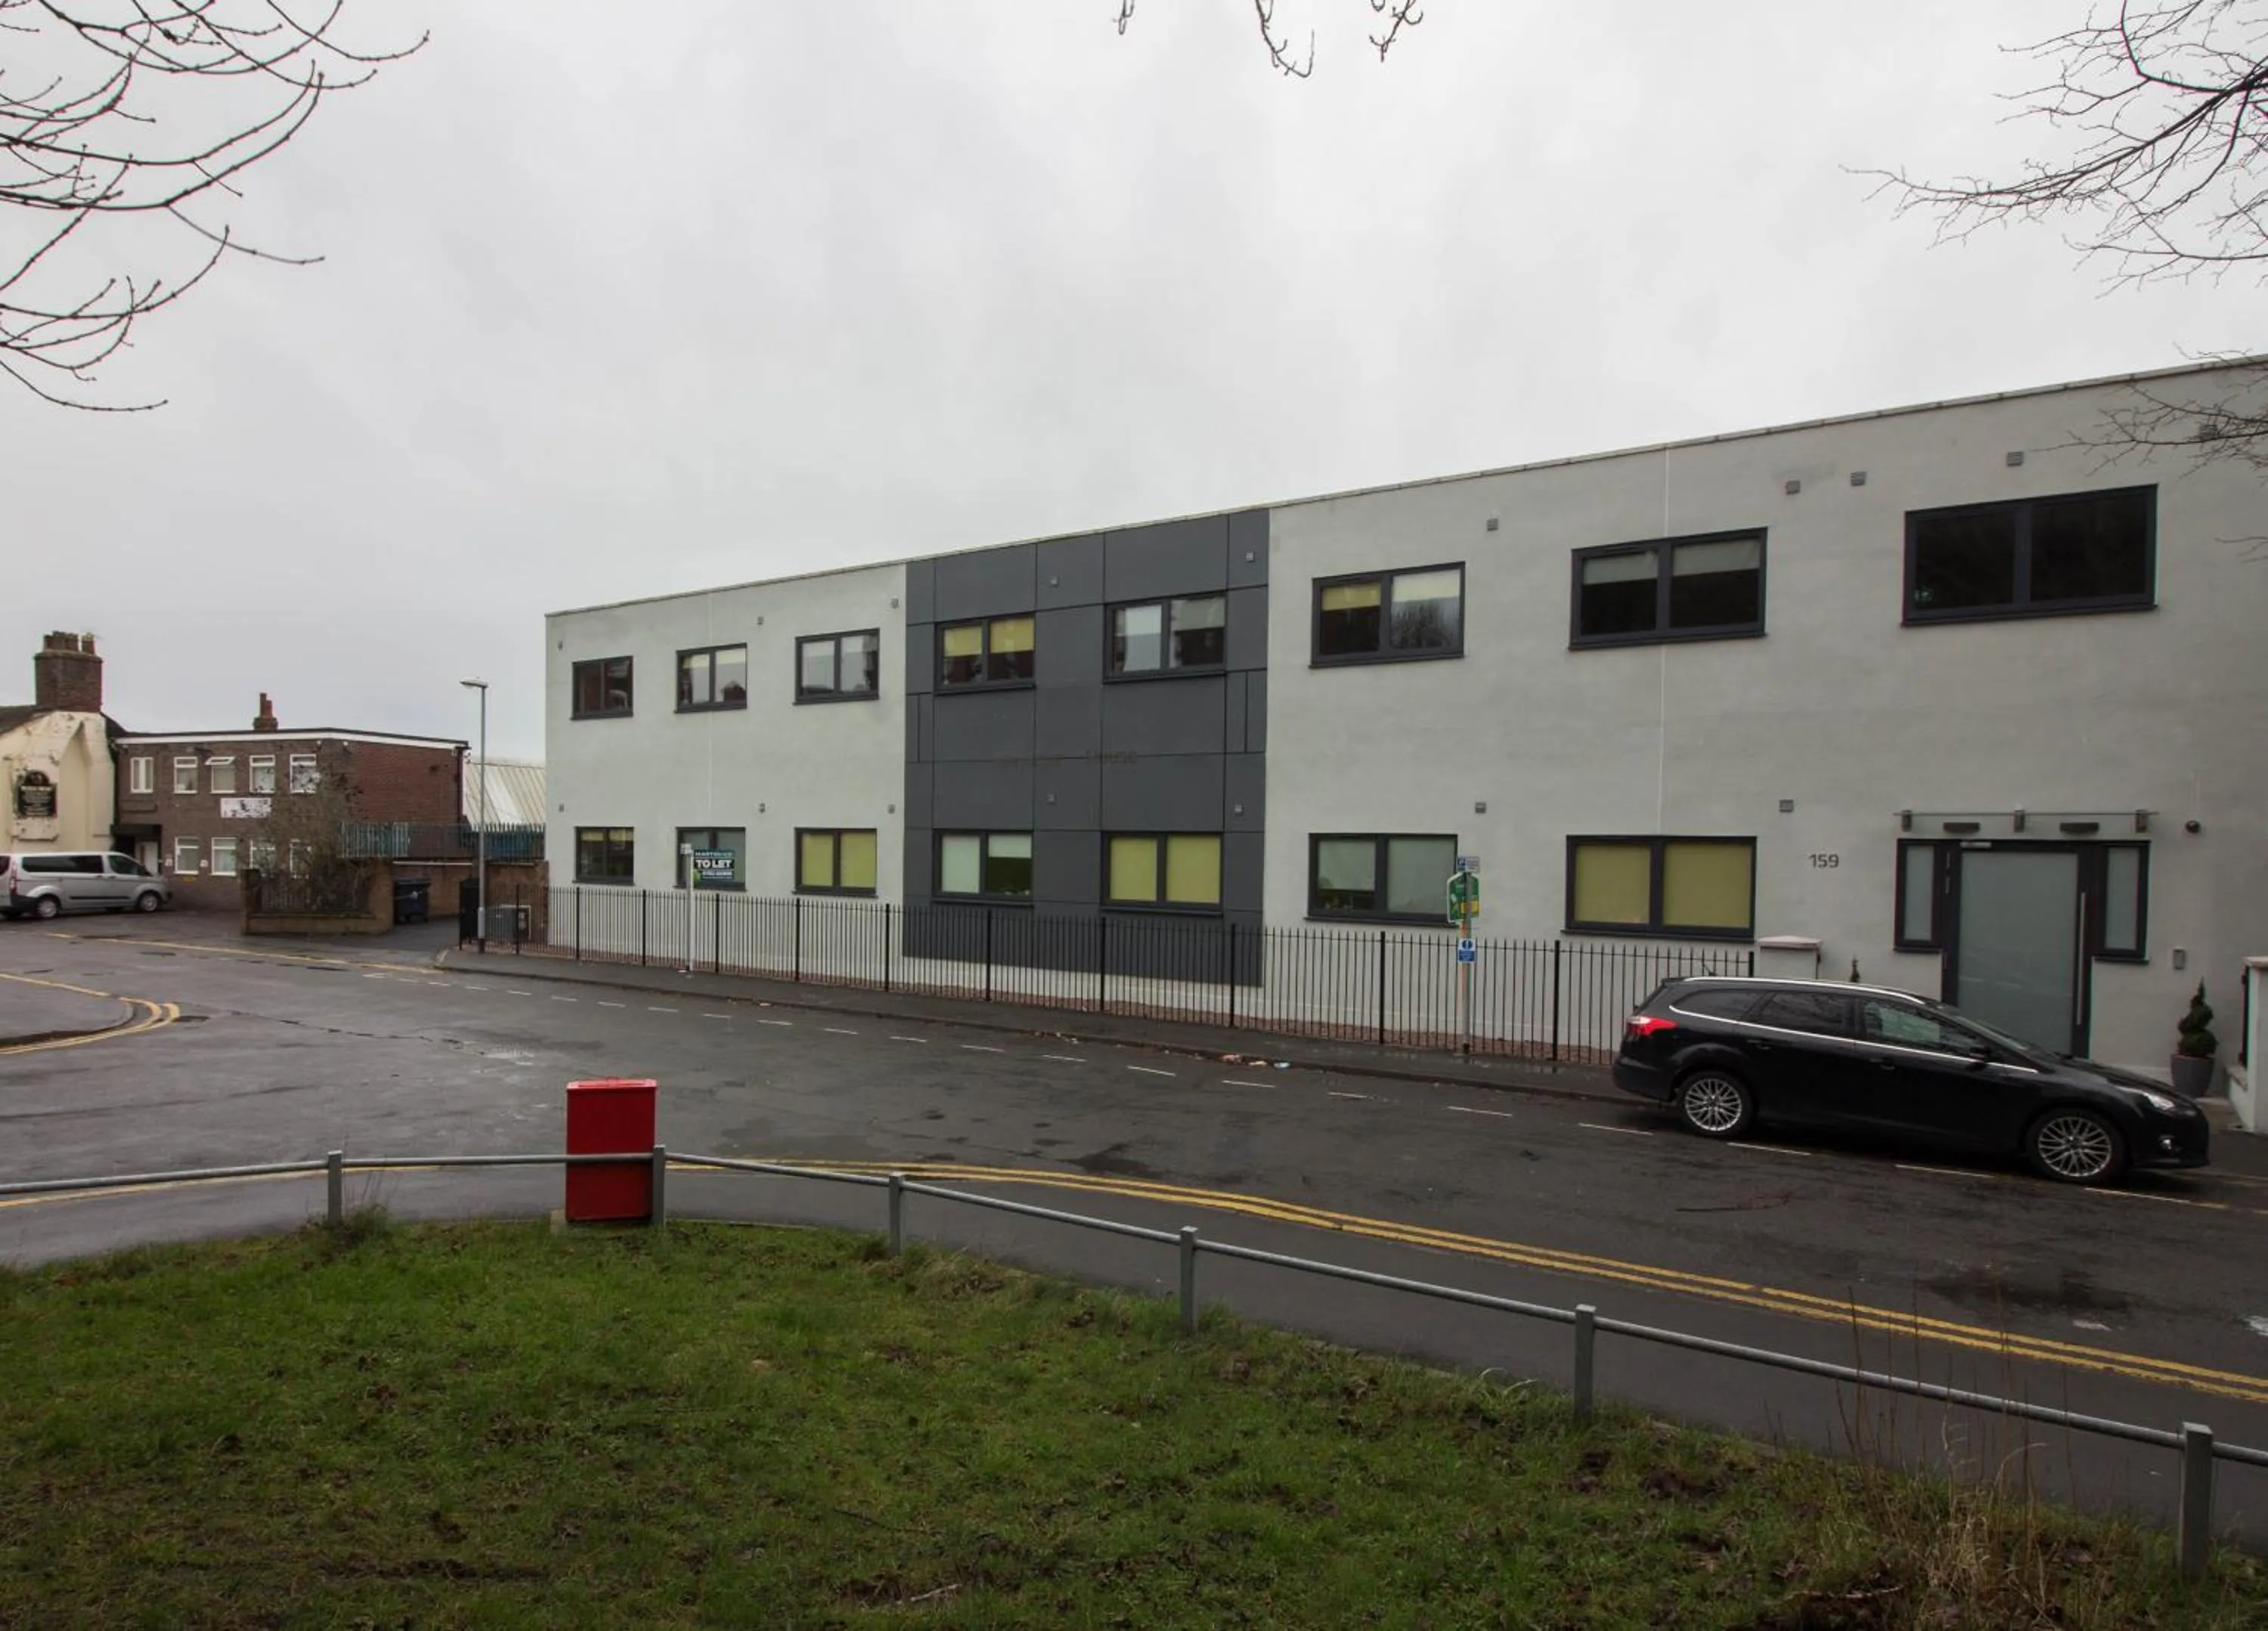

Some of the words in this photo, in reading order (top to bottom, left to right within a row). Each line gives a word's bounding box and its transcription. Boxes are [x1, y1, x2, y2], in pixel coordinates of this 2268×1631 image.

[696, 859, 711, 868] TO
[711, 859, 732, 868] LET
[1808, 853, 1839, 868] 159
